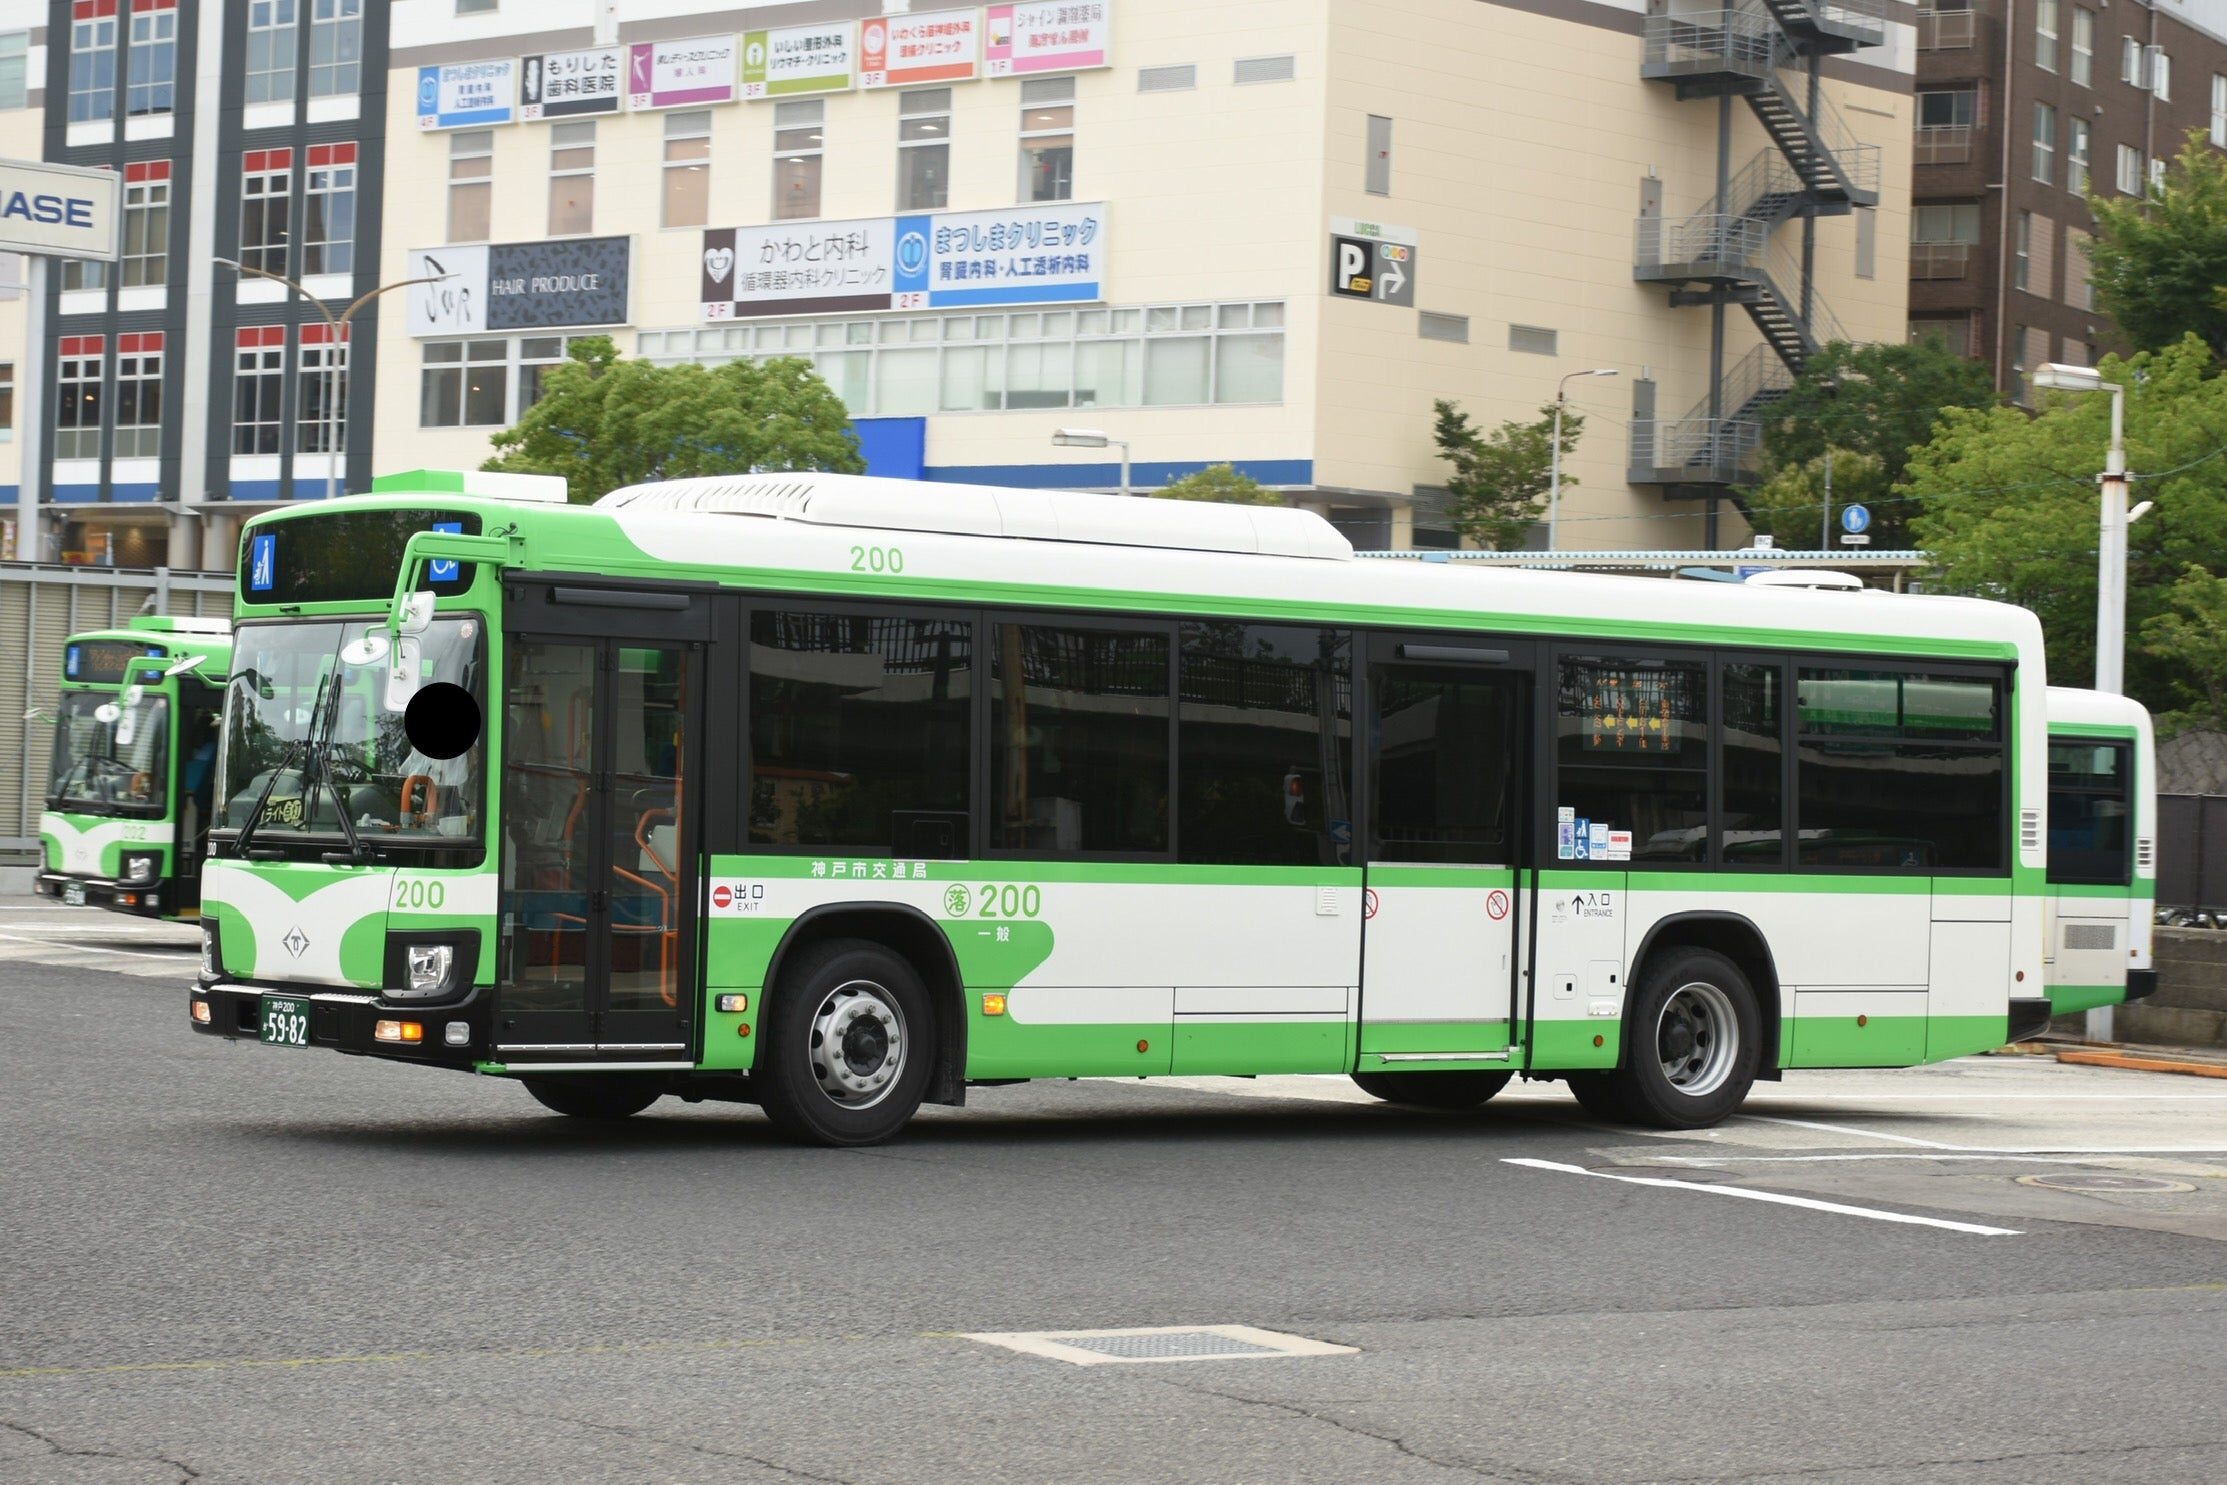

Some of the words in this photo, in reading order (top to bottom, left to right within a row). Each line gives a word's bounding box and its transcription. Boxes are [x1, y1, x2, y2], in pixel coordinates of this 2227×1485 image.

[547, 53, 617, 75] もりした
[546, 75, 615, 97] 歯科医院
[0, 189, 94, 229] ASE
[760, 229, 869, 264] かわと内科
[935, 217, 1098, 255] まつしまクリニック
[1339, 243, 1366, 290] P
[491, 278, 526, 296] HAIR
[531, 273, 600, 294] PRODUCE
[707, 303, 726, 318] 2F
[900, 293, 920, 309] 2F
[850, 545, 904, 574] 200
[811, 861, 927, 879] 神戸市交通局
[396, 880, 445, 909] 200
[734, 883, 764, 900] 出口
[979, 884, 1041, 918] 200
[1587, 892, 1610, 906] 入口
[737, 902, 759, 911] EXIT
[1583, 908, 1613, 918] ENTRANCE
[978, 926, 1010, 942] 一般
